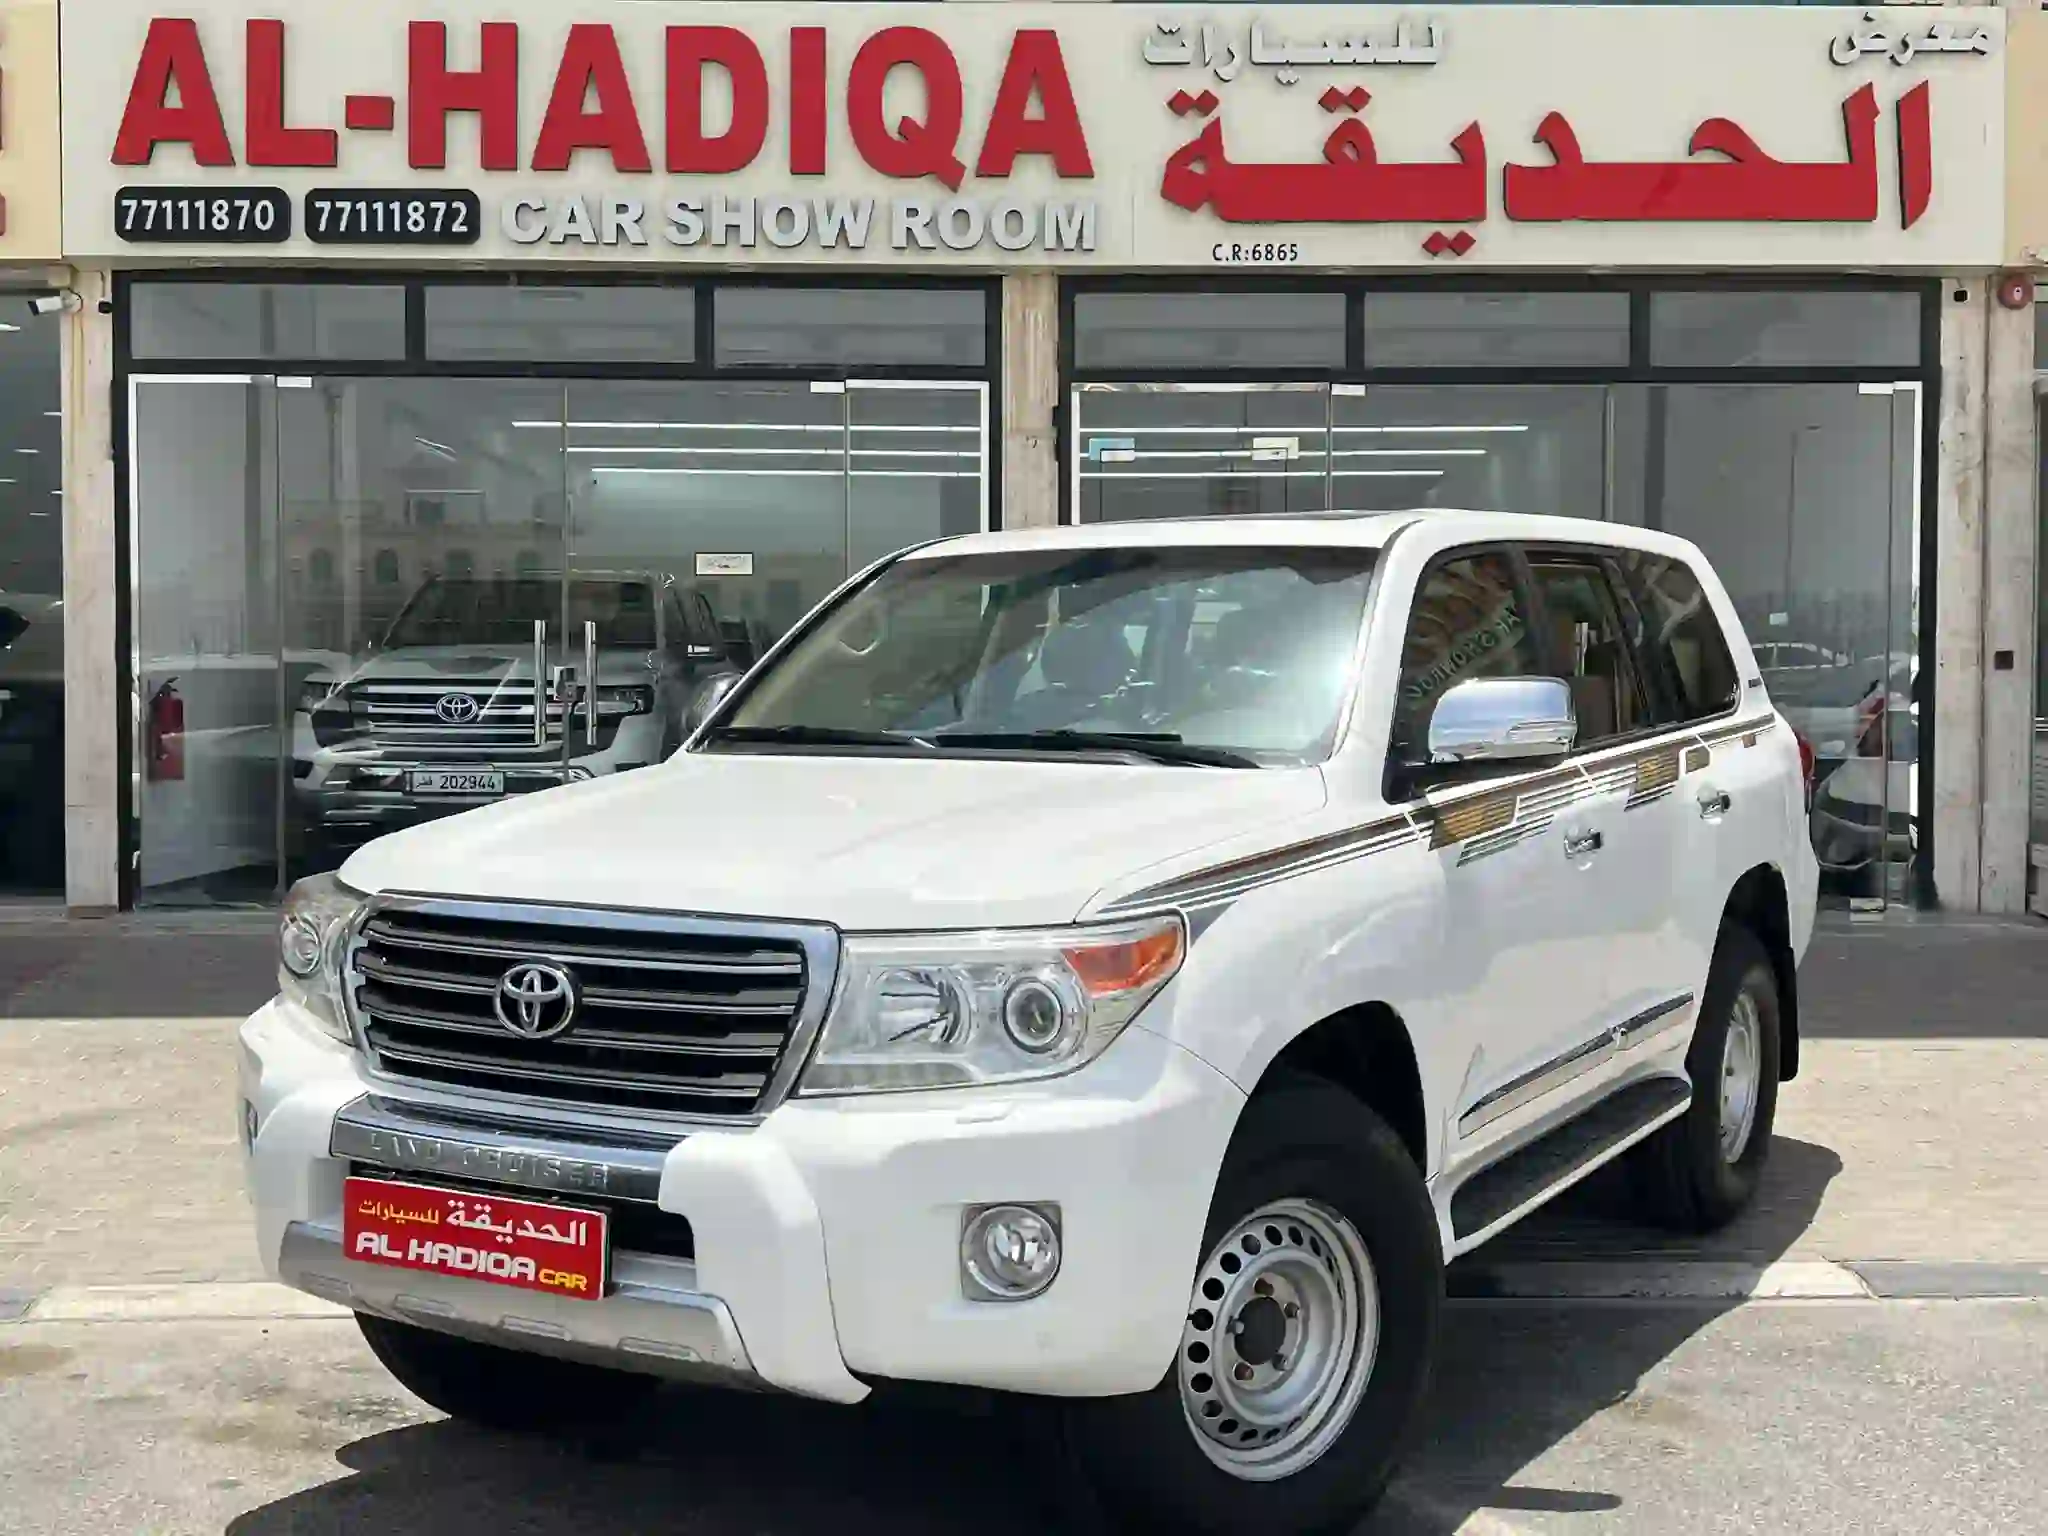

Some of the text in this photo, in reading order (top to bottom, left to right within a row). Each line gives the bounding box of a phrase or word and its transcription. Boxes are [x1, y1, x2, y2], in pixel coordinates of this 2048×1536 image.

[1143, 19, 1441, 83] للسيارات
[1829, 11, 1989, 66] معرض
[111, 18, 1095, 193] AL-HADIQA
[1160, 80, 1934, 255] الحديقة
[119, 198, 277, 232] 77111870
[312, 200, 470, 233] 77111872
[501, 197, 1096, 252] CAR SHOW ROOM
[440, 775, 495, 790] 202944
[371, 1132, 610, 1188] LAND CRUISER
[357, 1199, 588, 1246] الحديقة للسيارات
[355, 1231, 402, 1259] AL
[538, 1268, 588, 1291] CAR
